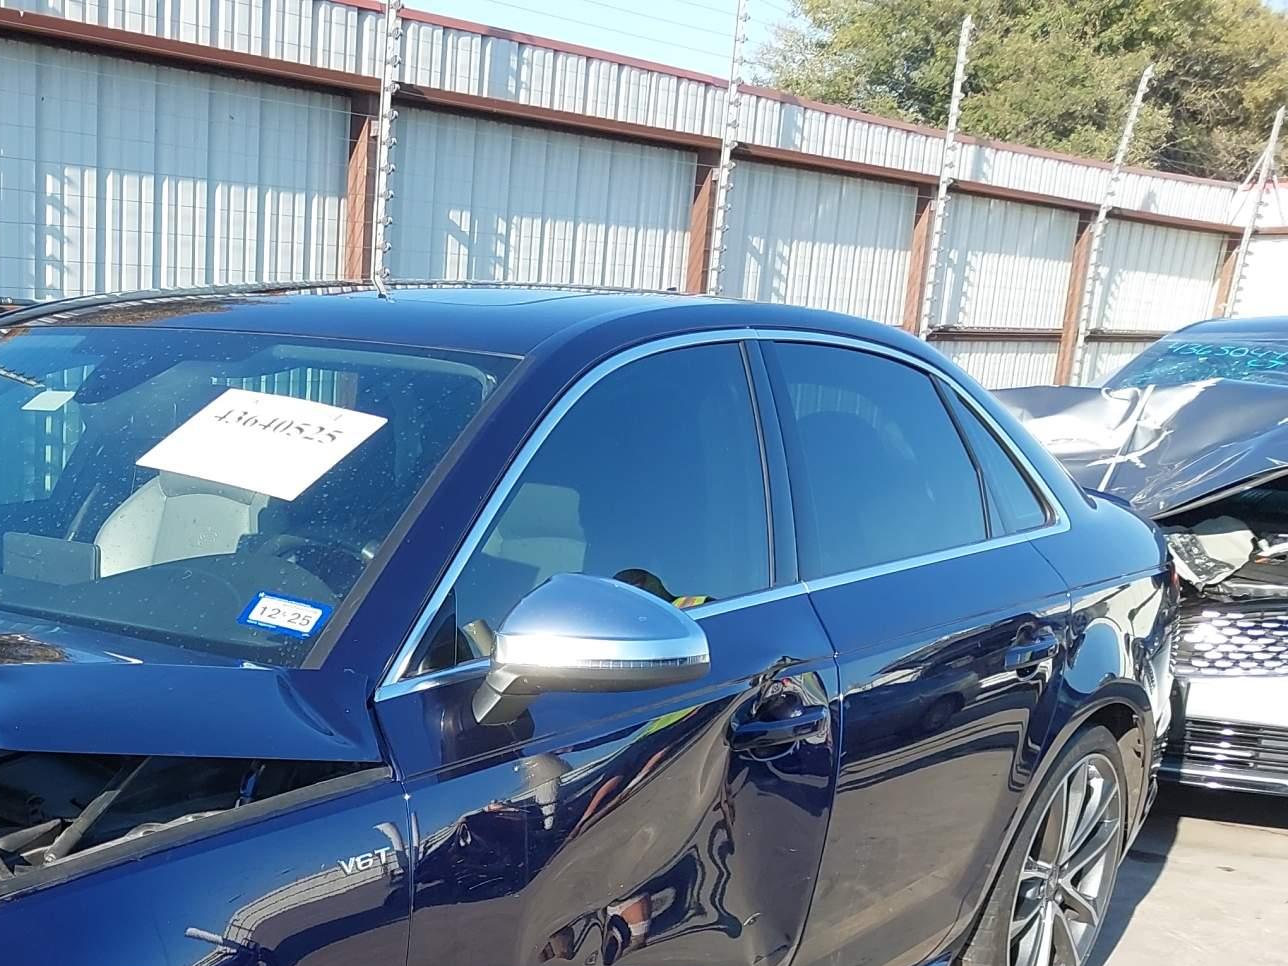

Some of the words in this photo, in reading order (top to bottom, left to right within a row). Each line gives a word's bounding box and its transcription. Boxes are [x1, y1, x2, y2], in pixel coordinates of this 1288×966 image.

[214, 409, 344, 443] 43640525
[259, 606, 281, 620] 12
[287, 612, 313, 627] 25
[337, 846, 392, 875] V6T
